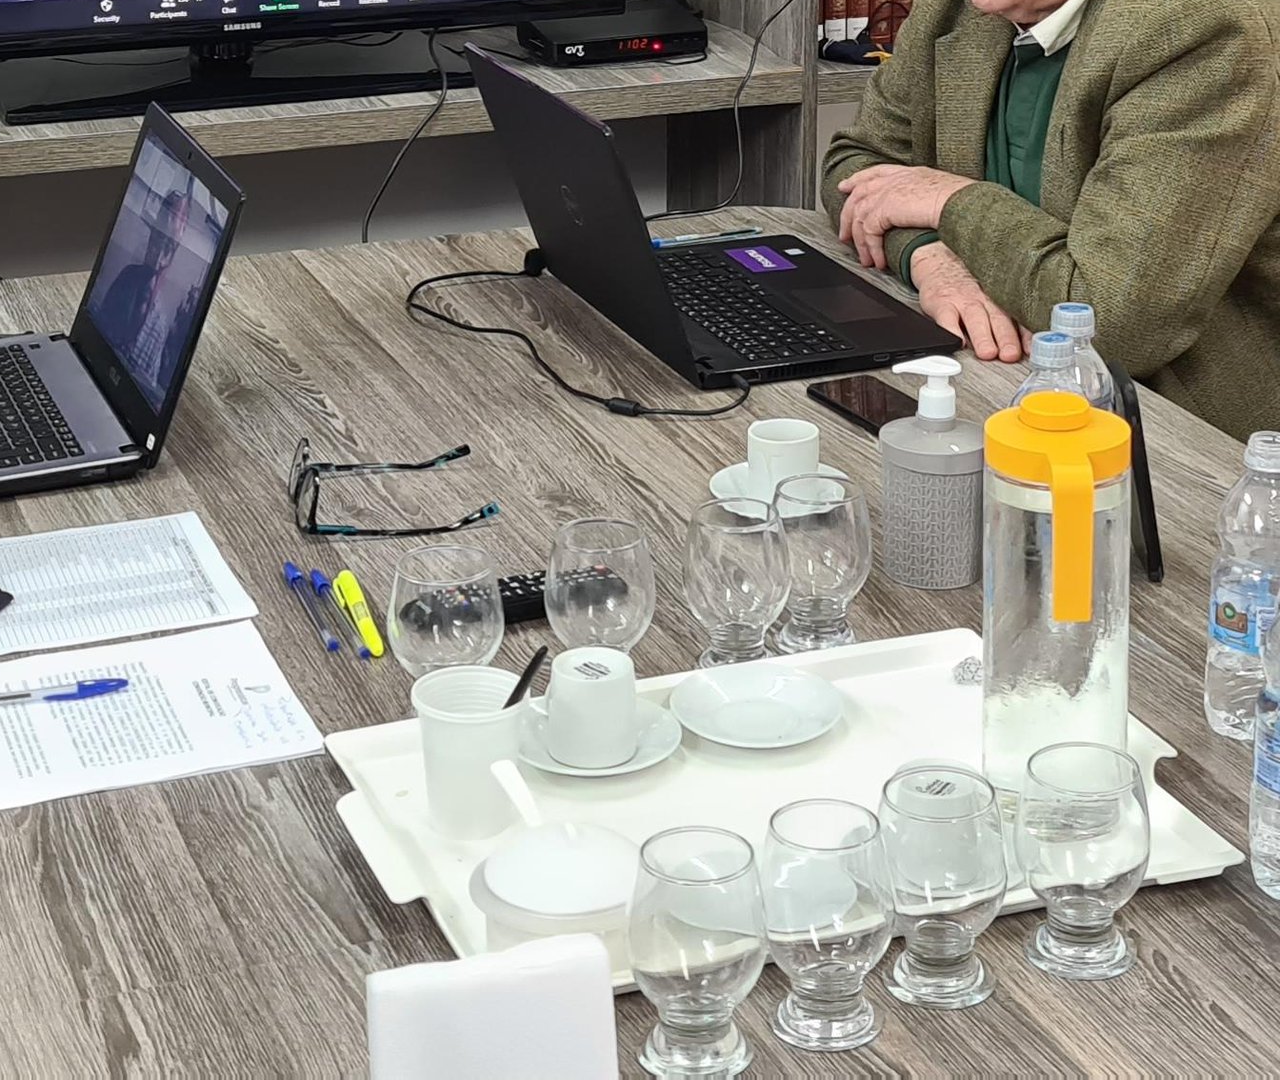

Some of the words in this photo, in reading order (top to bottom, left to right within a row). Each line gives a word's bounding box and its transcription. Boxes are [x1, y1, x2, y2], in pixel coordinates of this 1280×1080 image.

[318, 0, 340, 8] Record
[93, 15, 120, 24] Security
[150, 11, 188, 19] Participants
[223, 22, 262, 31] SAMSUNG
[619, 39, 648, 49] 1102
[565, 45, 585, 57] GVT
